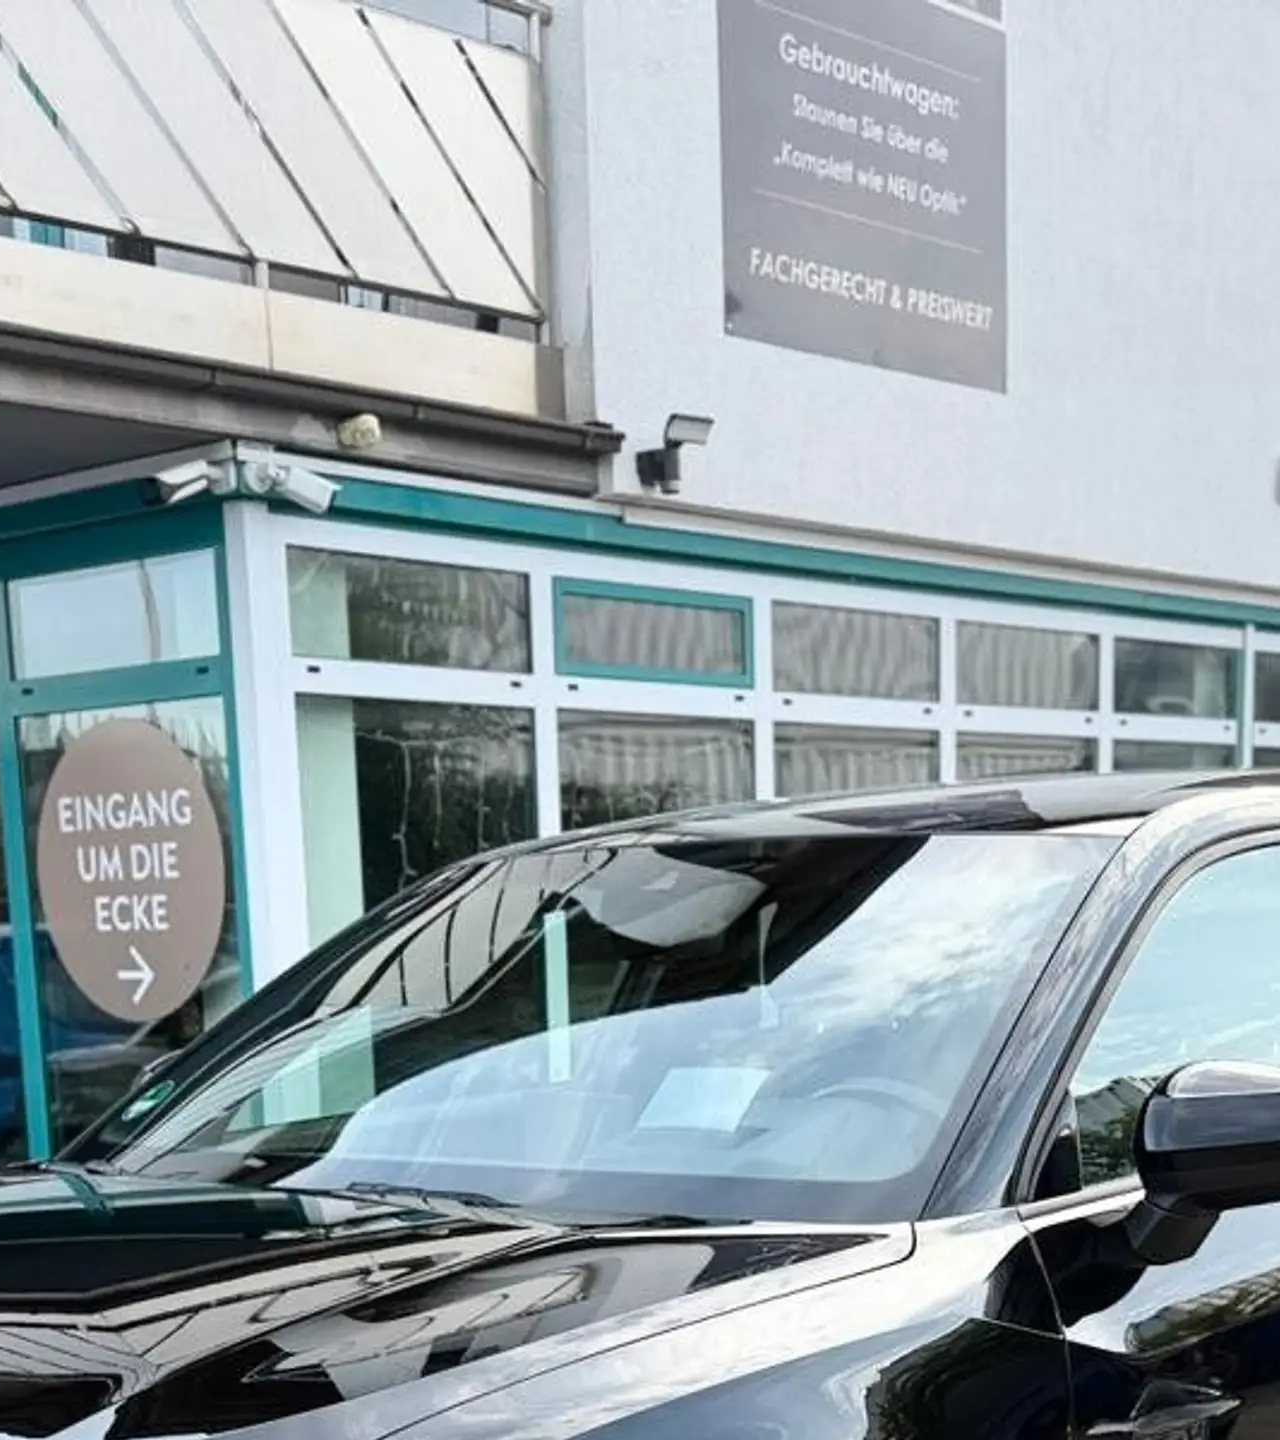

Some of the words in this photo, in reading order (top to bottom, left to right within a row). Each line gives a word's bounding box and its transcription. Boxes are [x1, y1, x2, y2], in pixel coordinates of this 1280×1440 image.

[779, 32, 959, 119] Gebrauchtwagen:
[793, 93, 858, 134] Staunen
[860, 115, 884, 143] Sie
[887, 123, 921, 154] über
[924, 137, 949, 163] die
[856, 166, 884, 193] wie
[887, 172, 917, 203] NEU
[749, 247, 887, 306] FACHGERECHT
[890, 284, 902, 309] &
[907, 287, 993, 330] PREISWERT
[57, 788, 192, 833] EINGANG
[76, 845, 122, 883] UM
[131, 841, 181, 881] DIE
[95, 894, 170, 932] ECKE
